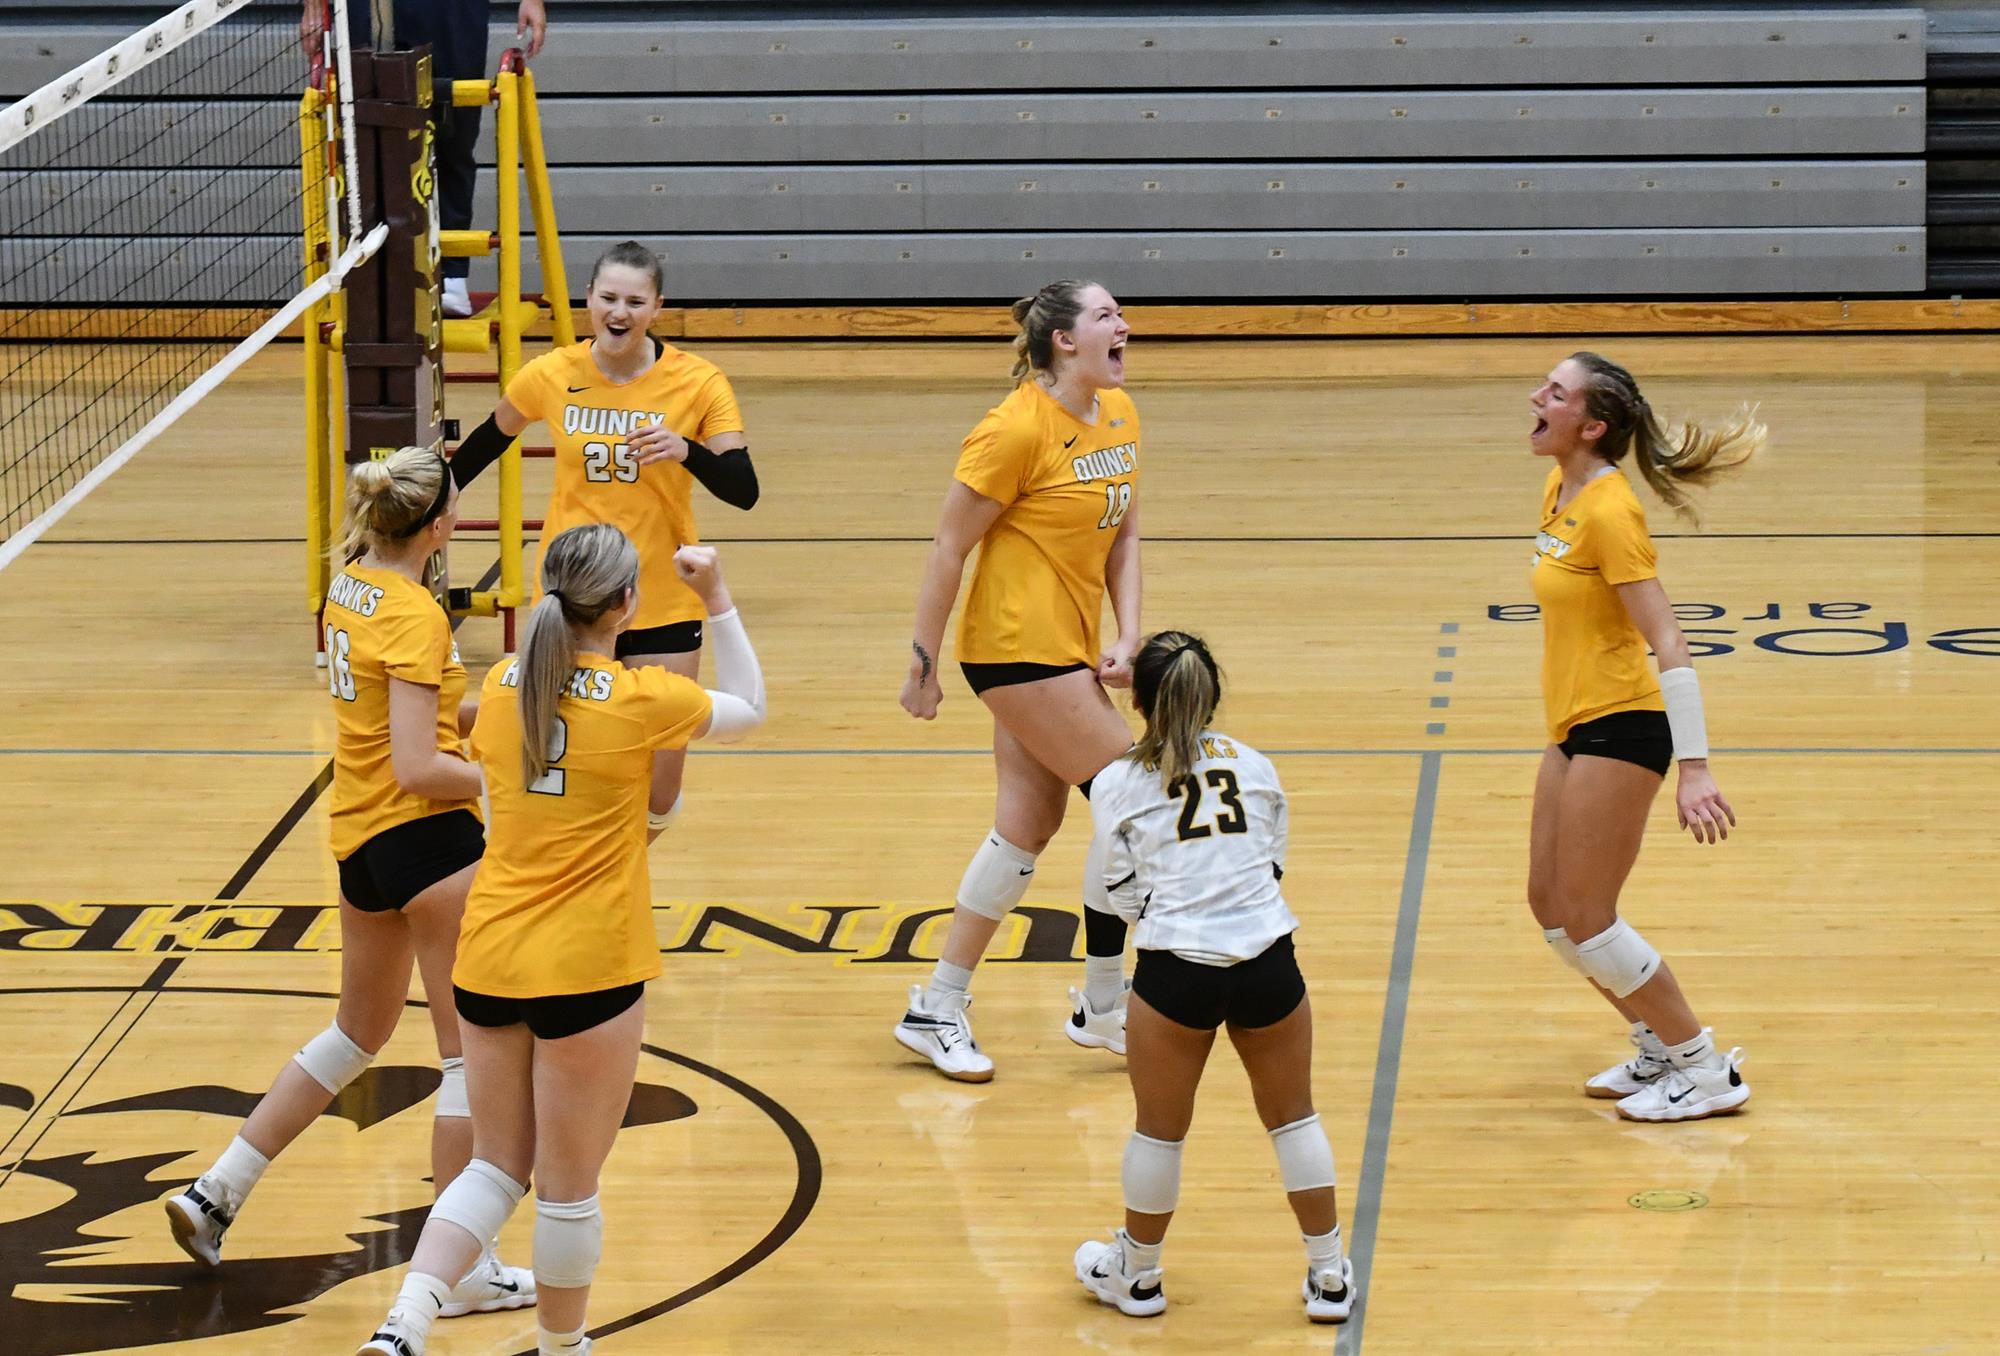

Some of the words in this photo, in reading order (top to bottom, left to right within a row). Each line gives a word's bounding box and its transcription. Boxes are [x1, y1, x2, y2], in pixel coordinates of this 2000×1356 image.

[583, 441, 640, 483] 25
[1488, 602, 1871, 621] area
[325, 622, 357, 702] 16
[499, 658, 615, 701] HKS
[526, 714, 568, 796] 2
[1167, 768, 1249, 842] 23
